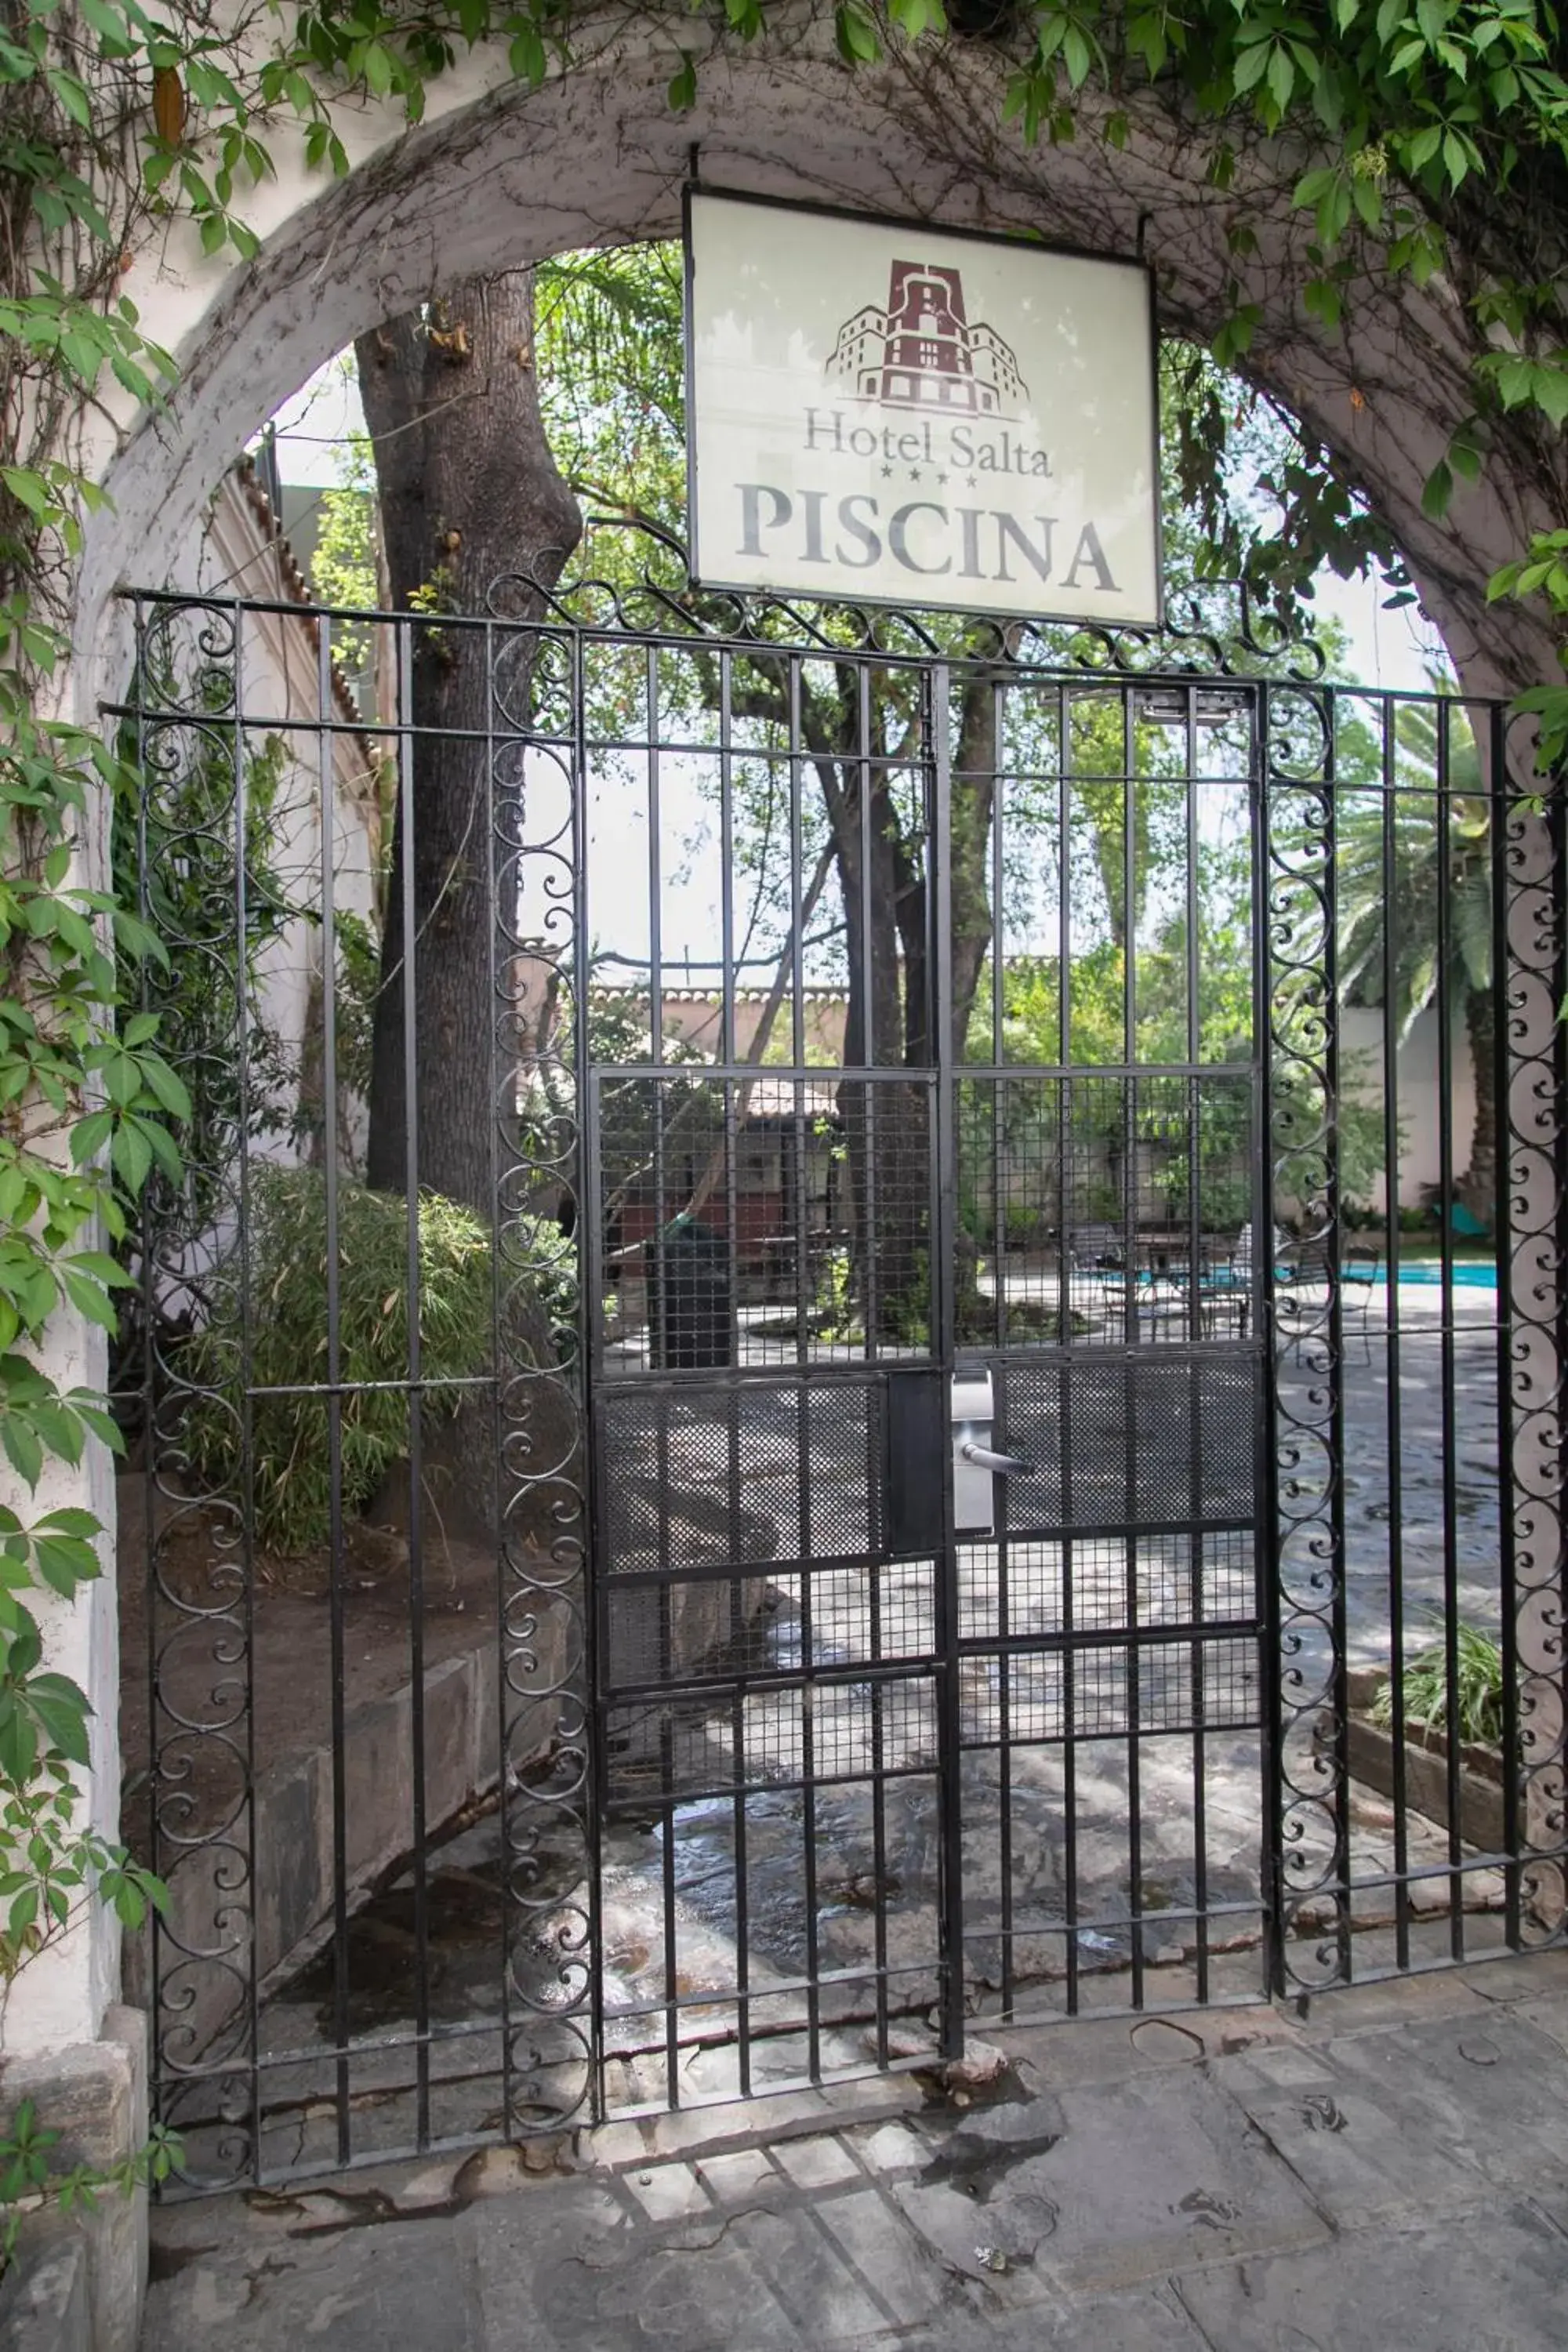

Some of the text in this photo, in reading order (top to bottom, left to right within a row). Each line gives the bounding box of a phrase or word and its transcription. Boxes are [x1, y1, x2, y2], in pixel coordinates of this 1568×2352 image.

[804, 407, 1054, 478] Hotel Salta
[733, 483, 1122, 591] PISCINA
